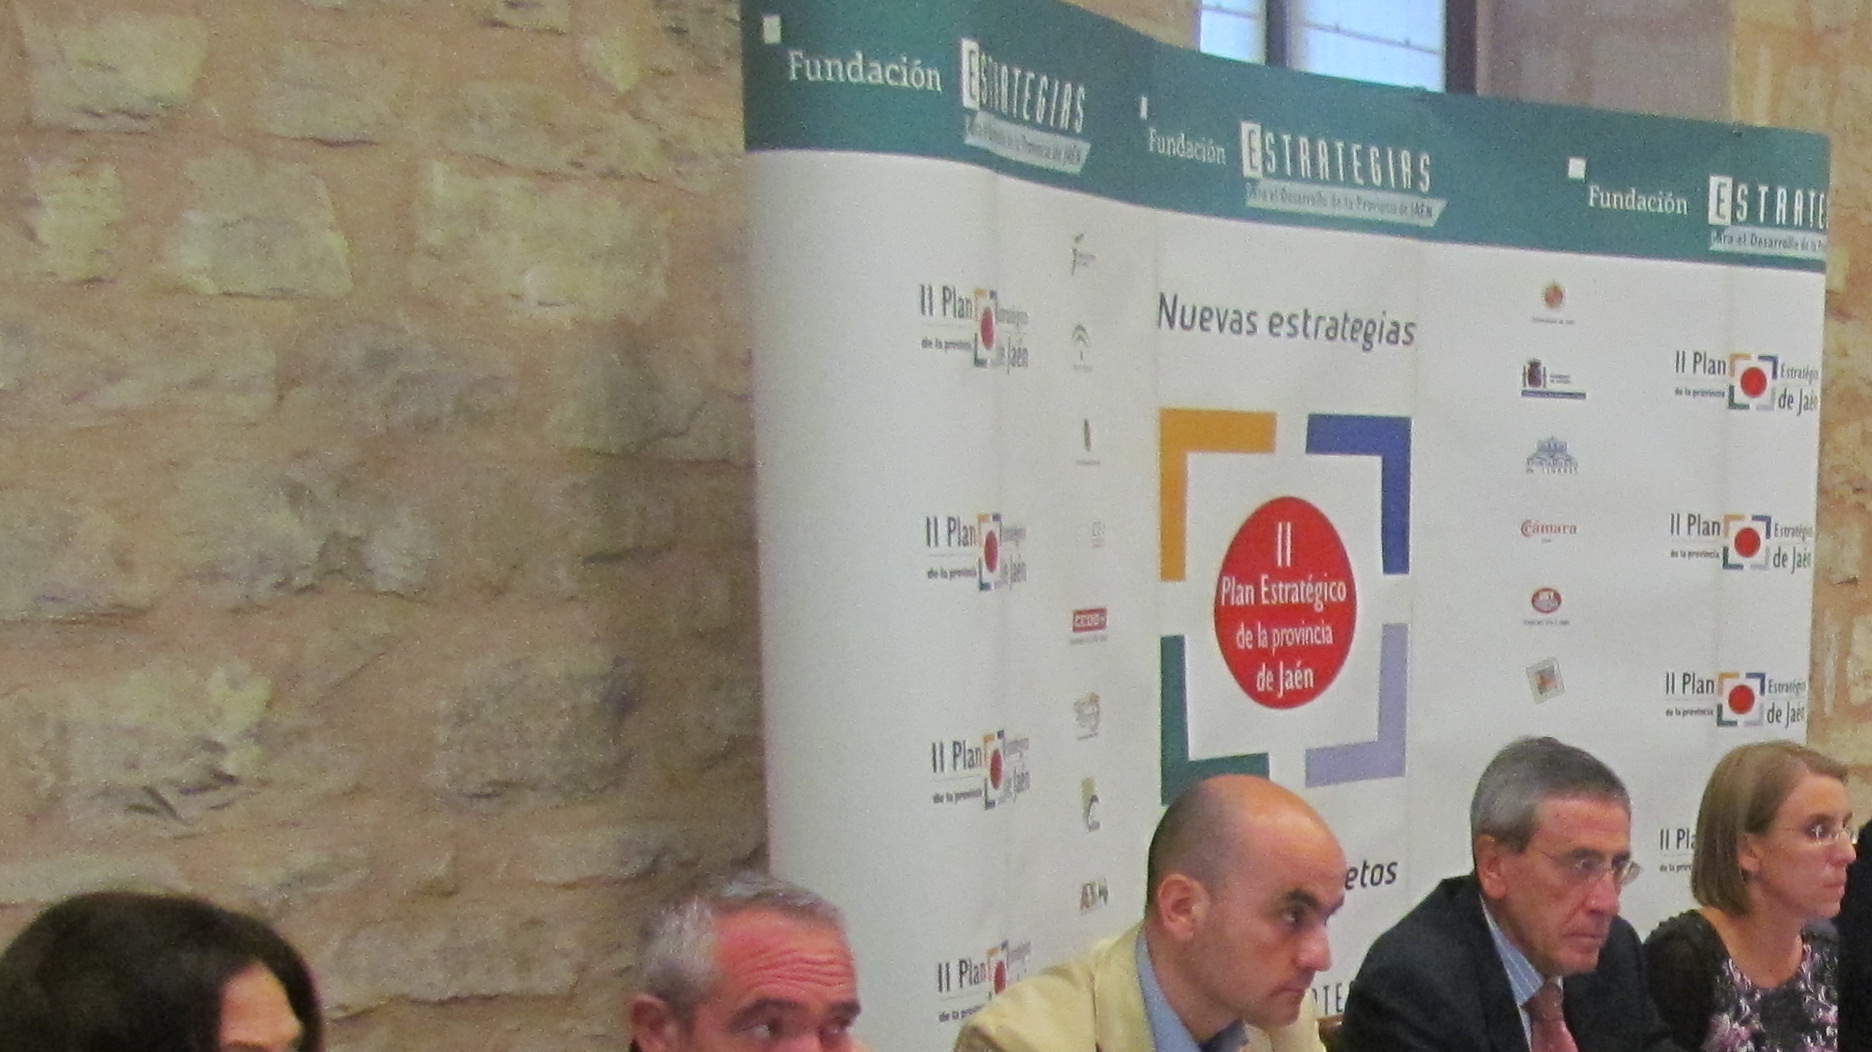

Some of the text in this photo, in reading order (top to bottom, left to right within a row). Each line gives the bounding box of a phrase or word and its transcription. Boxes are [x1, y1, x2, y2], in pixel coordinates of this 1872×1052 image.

[789, 48, 942, 92] Fundación
[1149, 127, 1226, 165] Fundación
[1241, 121, 1431, 192] ESTRATEGIAS
[1588, 175, 1829, 230] Fundación ESTRATE
[920, 284, 933, 316] II
[942, 285, 973, 318] Plan
[1158, 292, 1418, 352] Nuevas estrategias
[1675, 350, 1686, 374] II
[1693, 351, 1726, 376] Plan
[1778, 386, 1794, 410] de
[926, 515, 938, 547] II
[947, 515, 976, 548] Plan
[1671, 513, 1680, 535] II
[1687, 513, 1720, 536] Plan
[1277, 521, 1292, 568] II
[1773, 545, 1788, 568] de
[1221, 573, 1347, 612] Plan Estratégico
[1236, 620, 1334, 656] de la provincia
[1256, 660, 1314, 699] de Jaén
[1666, 672, 1675, 695] II
[1682, 672, 1714, 695] Plan
[1767, 701, 1782, 724] de
[932, 739, 944, 773] II
[953, 740, 982, 771] Plan
[1344, 859, 1398, 890] etos
[959, 957, 987, 988] Plan
